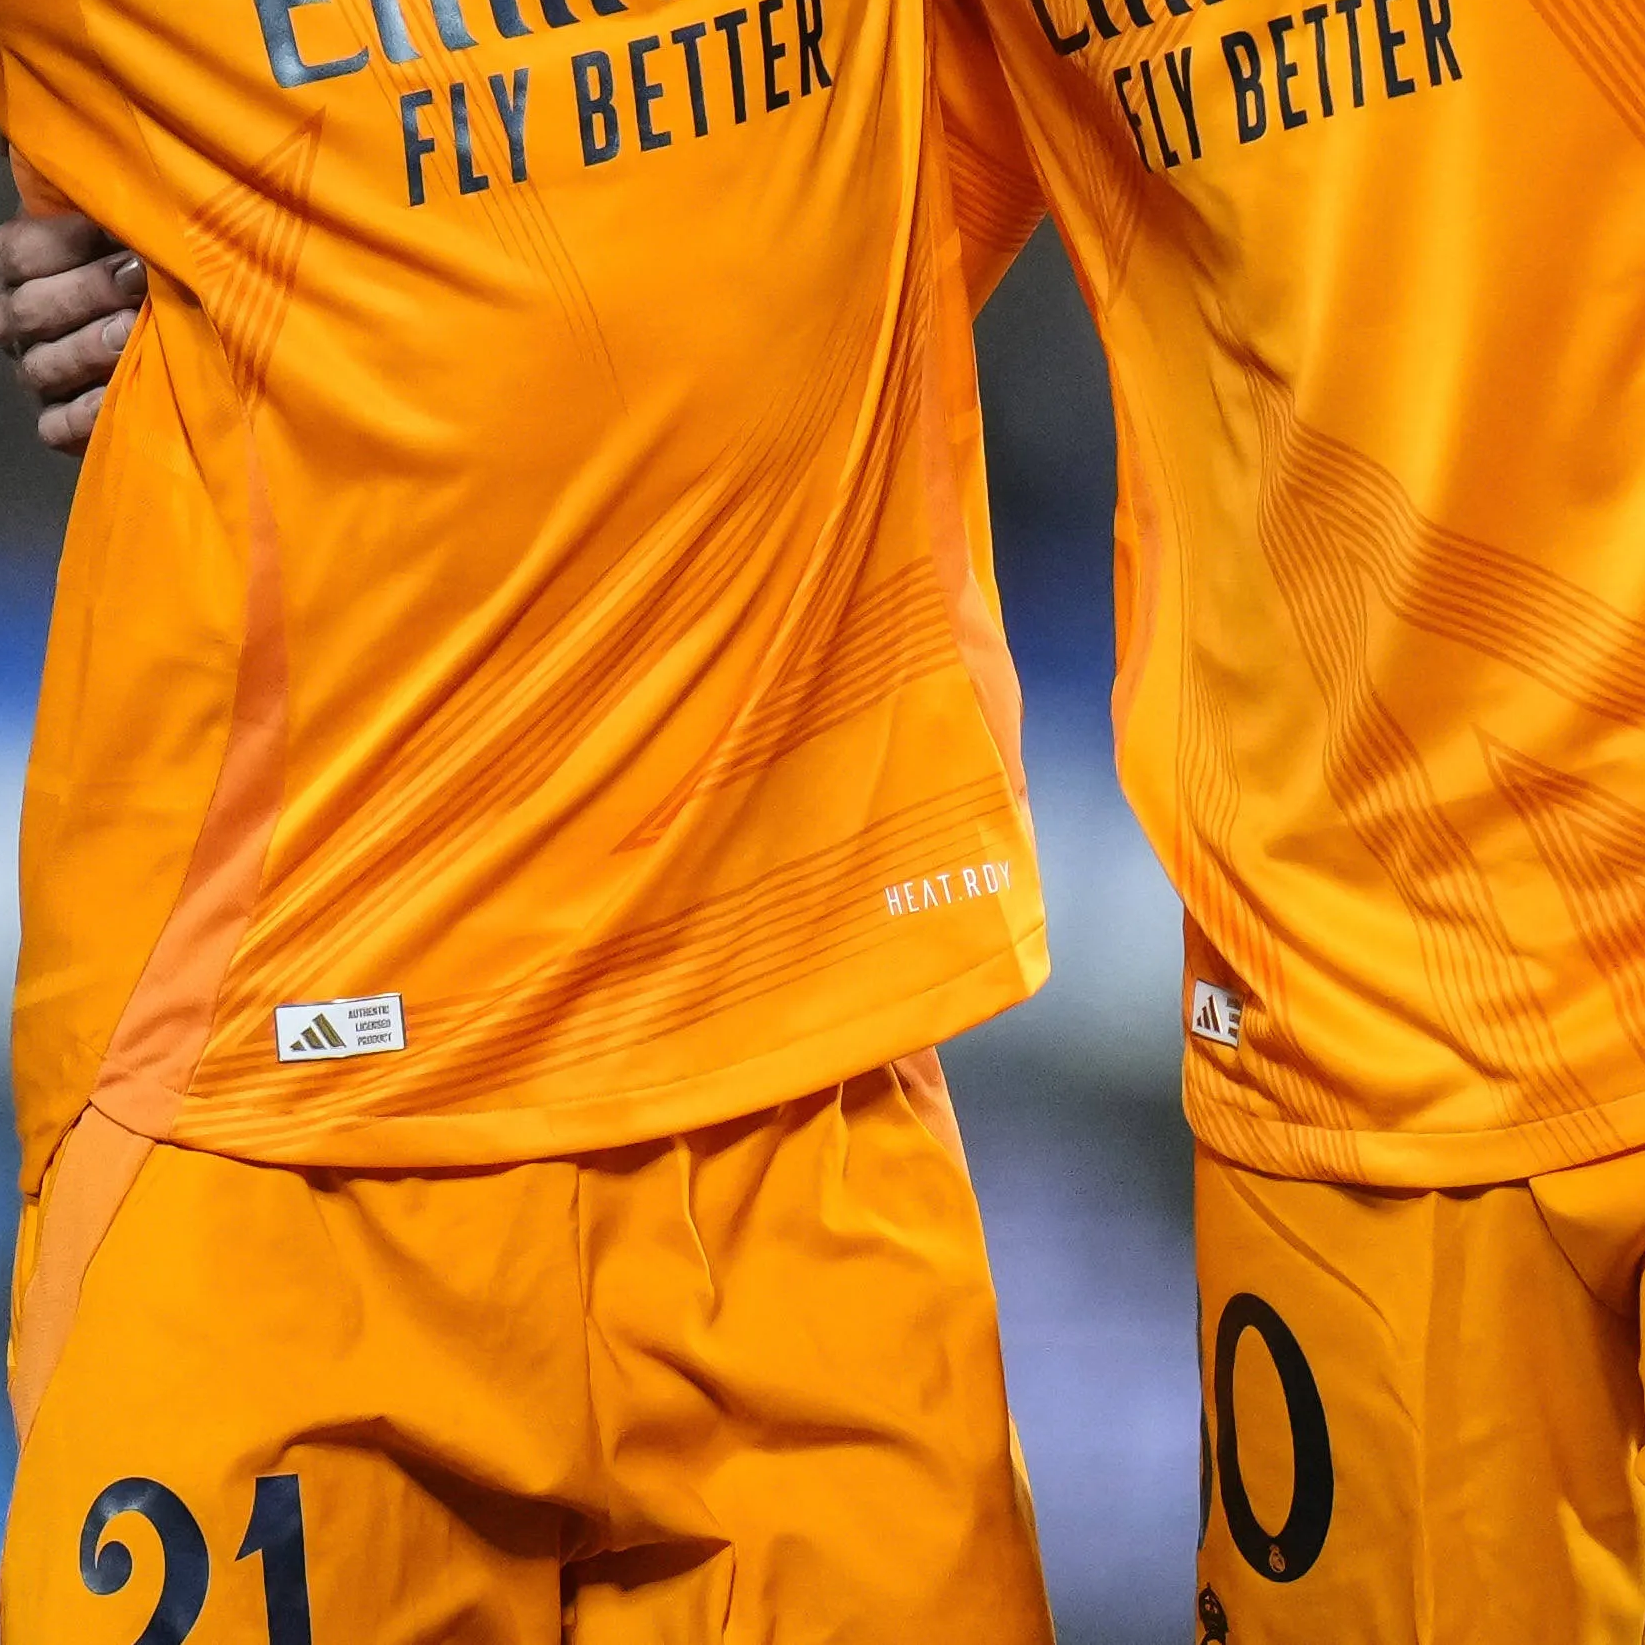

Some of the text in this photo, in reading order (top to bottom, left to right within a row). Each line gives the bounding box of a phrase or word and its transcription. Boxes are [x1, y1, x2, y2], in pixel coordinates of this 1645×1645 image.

[401, 67, 530, 207] FLY
[1113, 45, 1202, 175] FLY
[884, 859, 1011, 916] HEAT.RDY
[79, 1473, 312, 1644] 21
